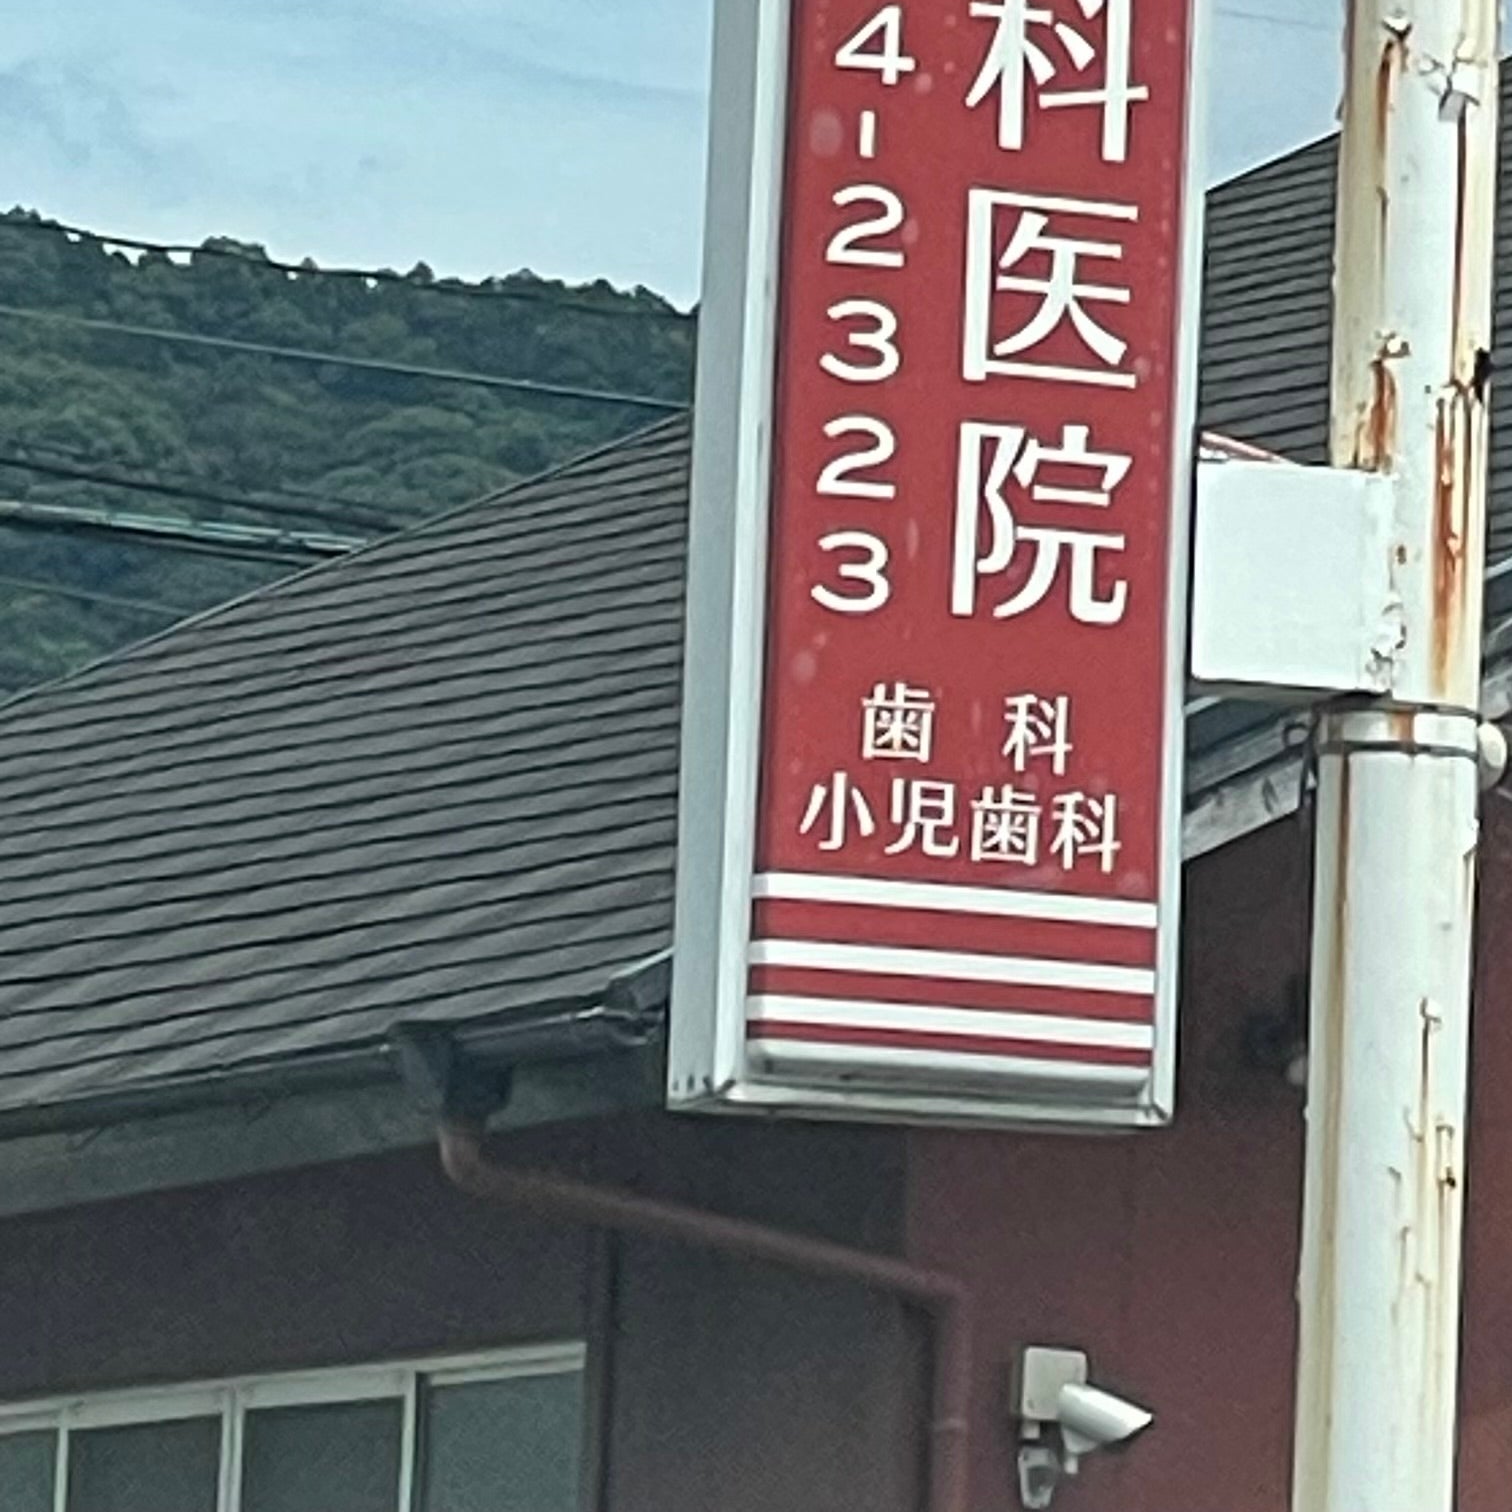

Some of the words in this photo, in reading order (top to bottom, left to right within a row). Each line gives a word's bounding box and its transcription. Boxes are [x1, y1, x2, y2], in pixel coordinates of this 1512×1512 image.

[861, 682, 935, 763] 歯
[1002, 693, 1073, 775] 科
[799, 771, 1122, 872] 小児歯科
